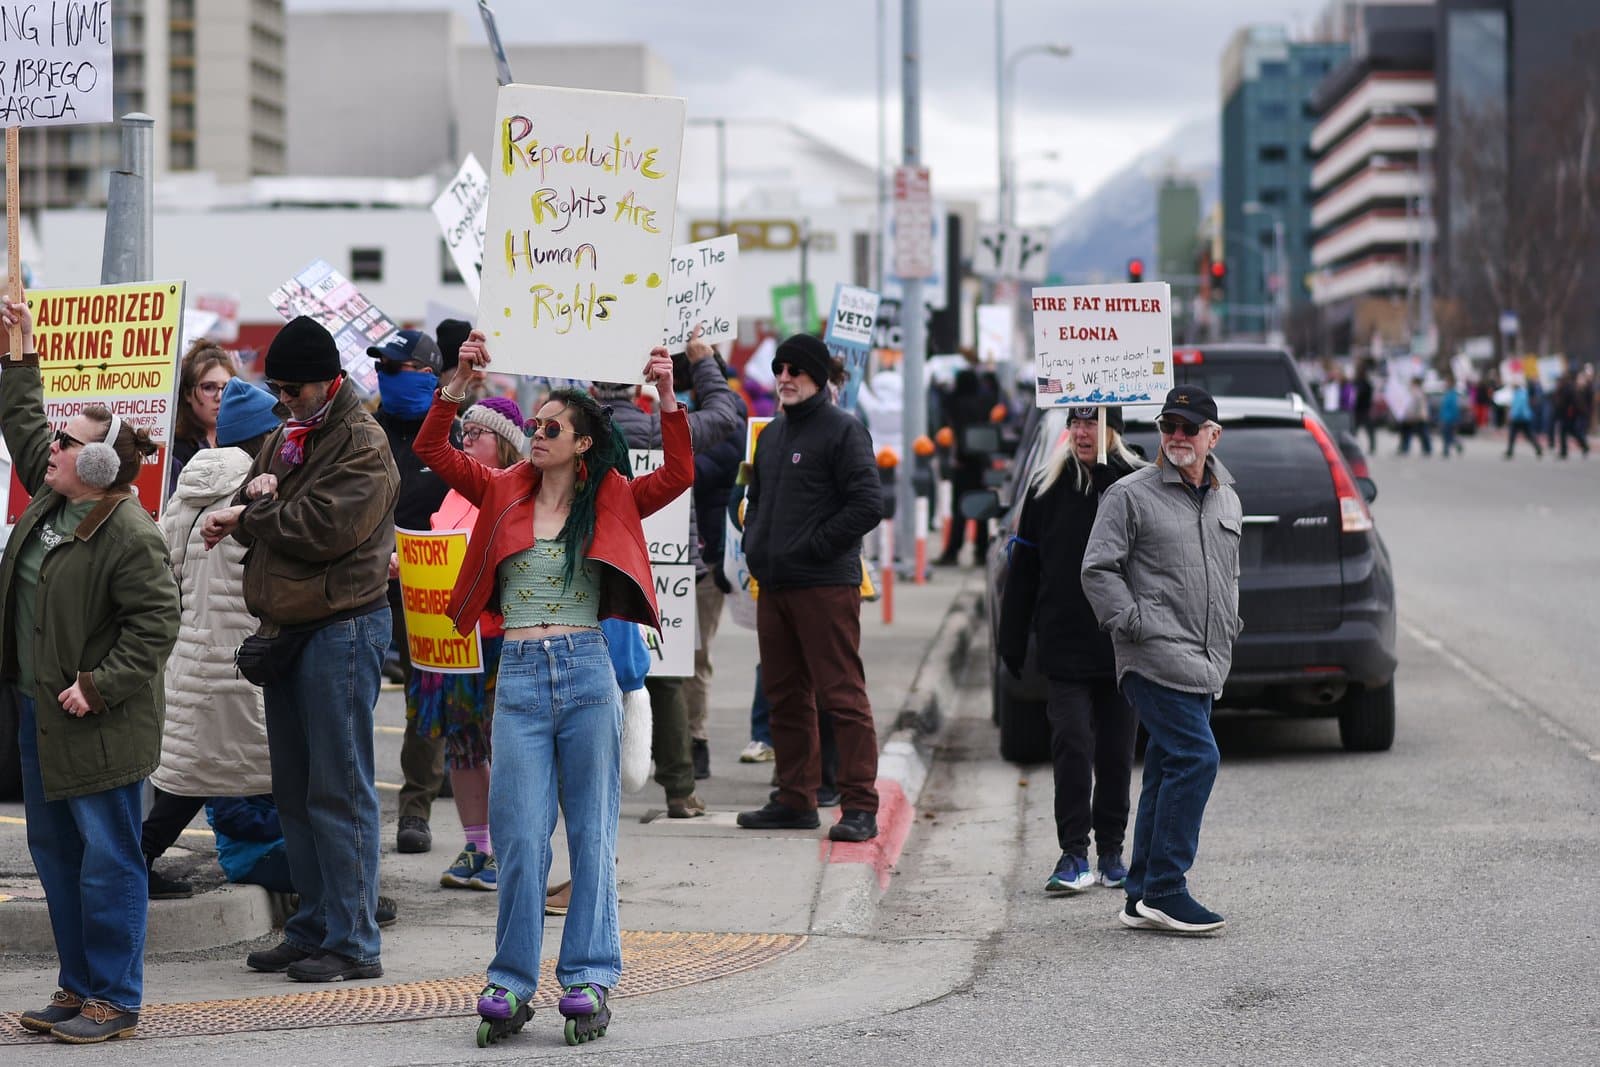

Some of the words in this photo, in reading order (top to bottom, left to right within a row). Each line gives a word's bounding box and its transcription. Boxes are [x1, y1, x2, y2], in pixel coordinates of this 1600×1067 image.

[51, 0, 109, 47] HOME
[13, 58, 98, 93] ABREGO
[501, 115, 667, 184] Reproductive
[531, 186, 608, 233] Rights
[505, 229, 598, 279] Human
[699, 247, 726, 267] The
[37, 291, 165, 327] AUTHORIZED
[529, 282, 618, 335] Rights
[678, 306, 702, 321] For
[836, 309, 873, 329] VETO
[1032, 297, 1067, 312] FIRE
[1073, 296, 1101, 311] FAT
[1105, 298, 1161, 313] HITLER
[32, 329, 114, 361] ARKING
[122, 326, 174, 358] ONLY
[1059, 326, 1118, 341] ELONIA
[51, 373, 91, 392] HOUR
[96, 371, 161, 390] IMPOUND
[1101, 368, 1118, 383] THE
[111, 399, 167, 415] VEHICLES
[401, 537, 449, 566] HISTORY
[402, 582, 453, 616] REMEMBE
[409, 633, 471, 664] COMPLICITY
